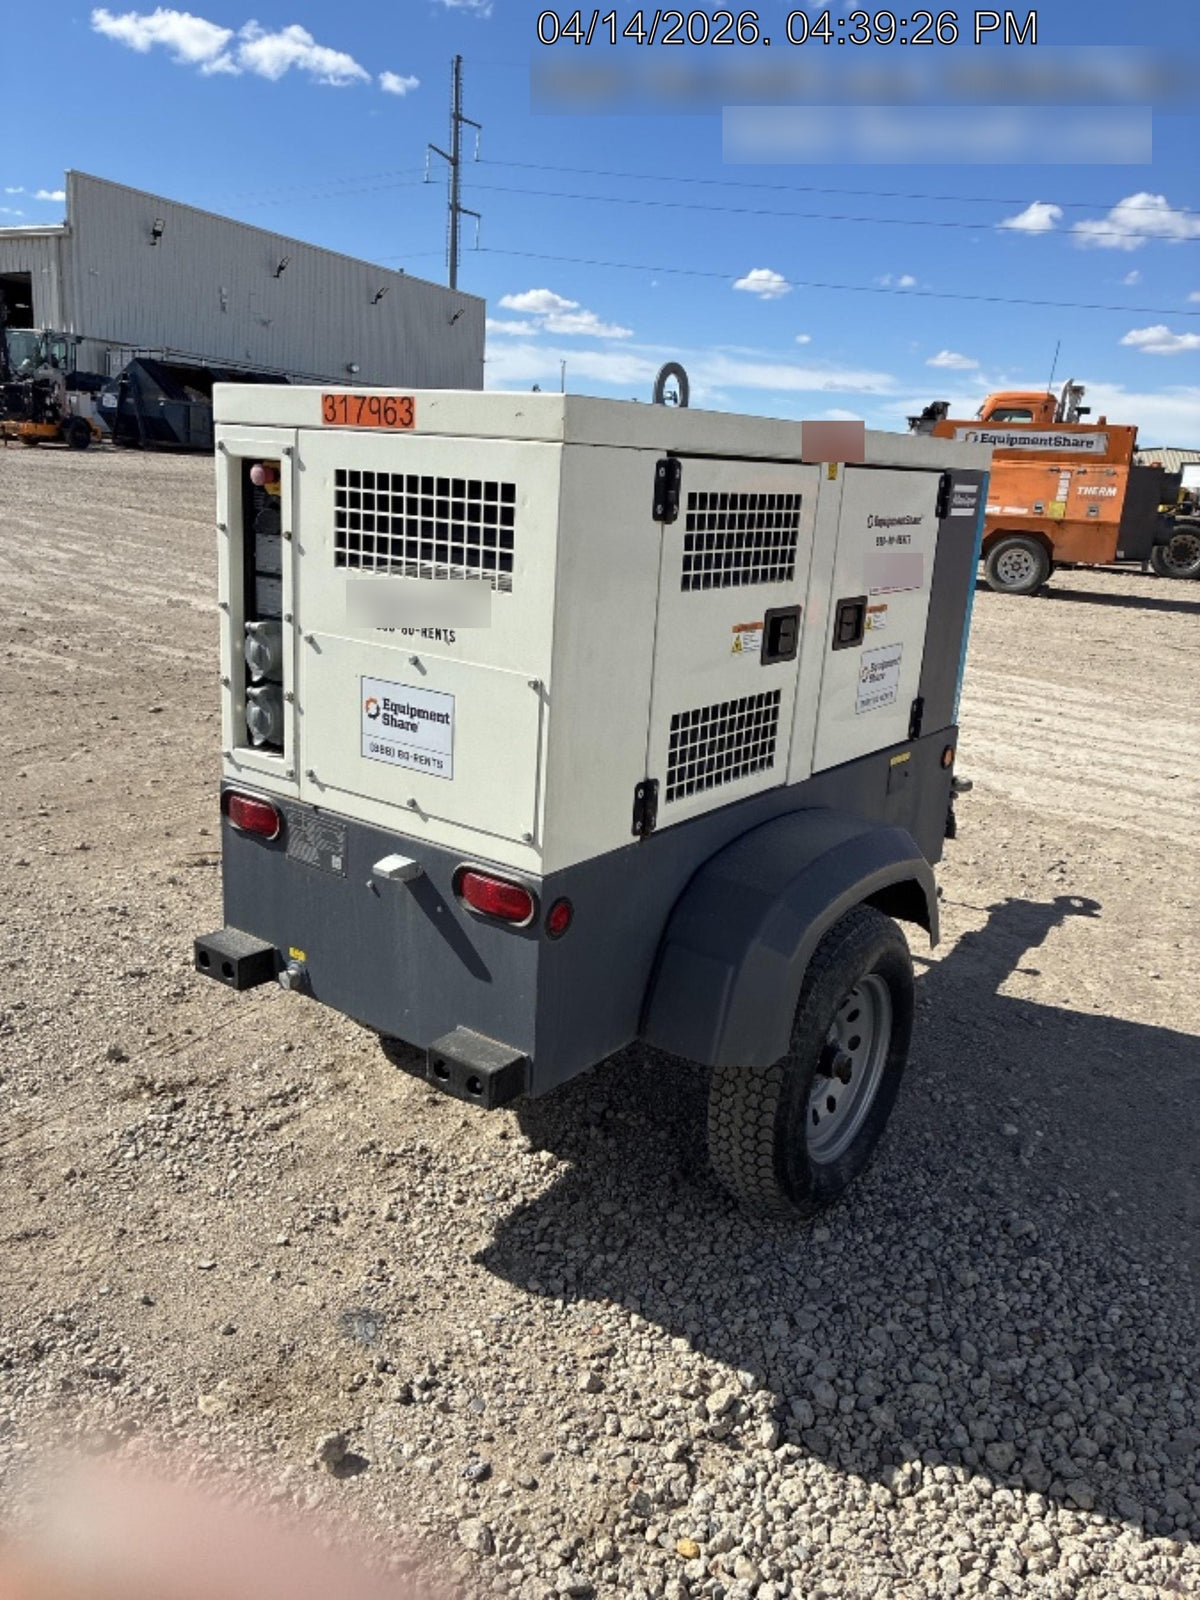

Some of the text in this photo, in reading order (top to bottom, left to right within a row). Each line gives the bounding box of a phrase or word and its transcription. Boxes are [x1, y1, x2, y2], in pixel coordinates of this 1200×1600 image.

[324, 394, 413, 426] 317963
[980, 433, 1094, 449] EquipmentShare
[382, 698, 450, 724] Equipment
[382, 713, 418, 733] Share
[369, 741, 395, 758] (888)
